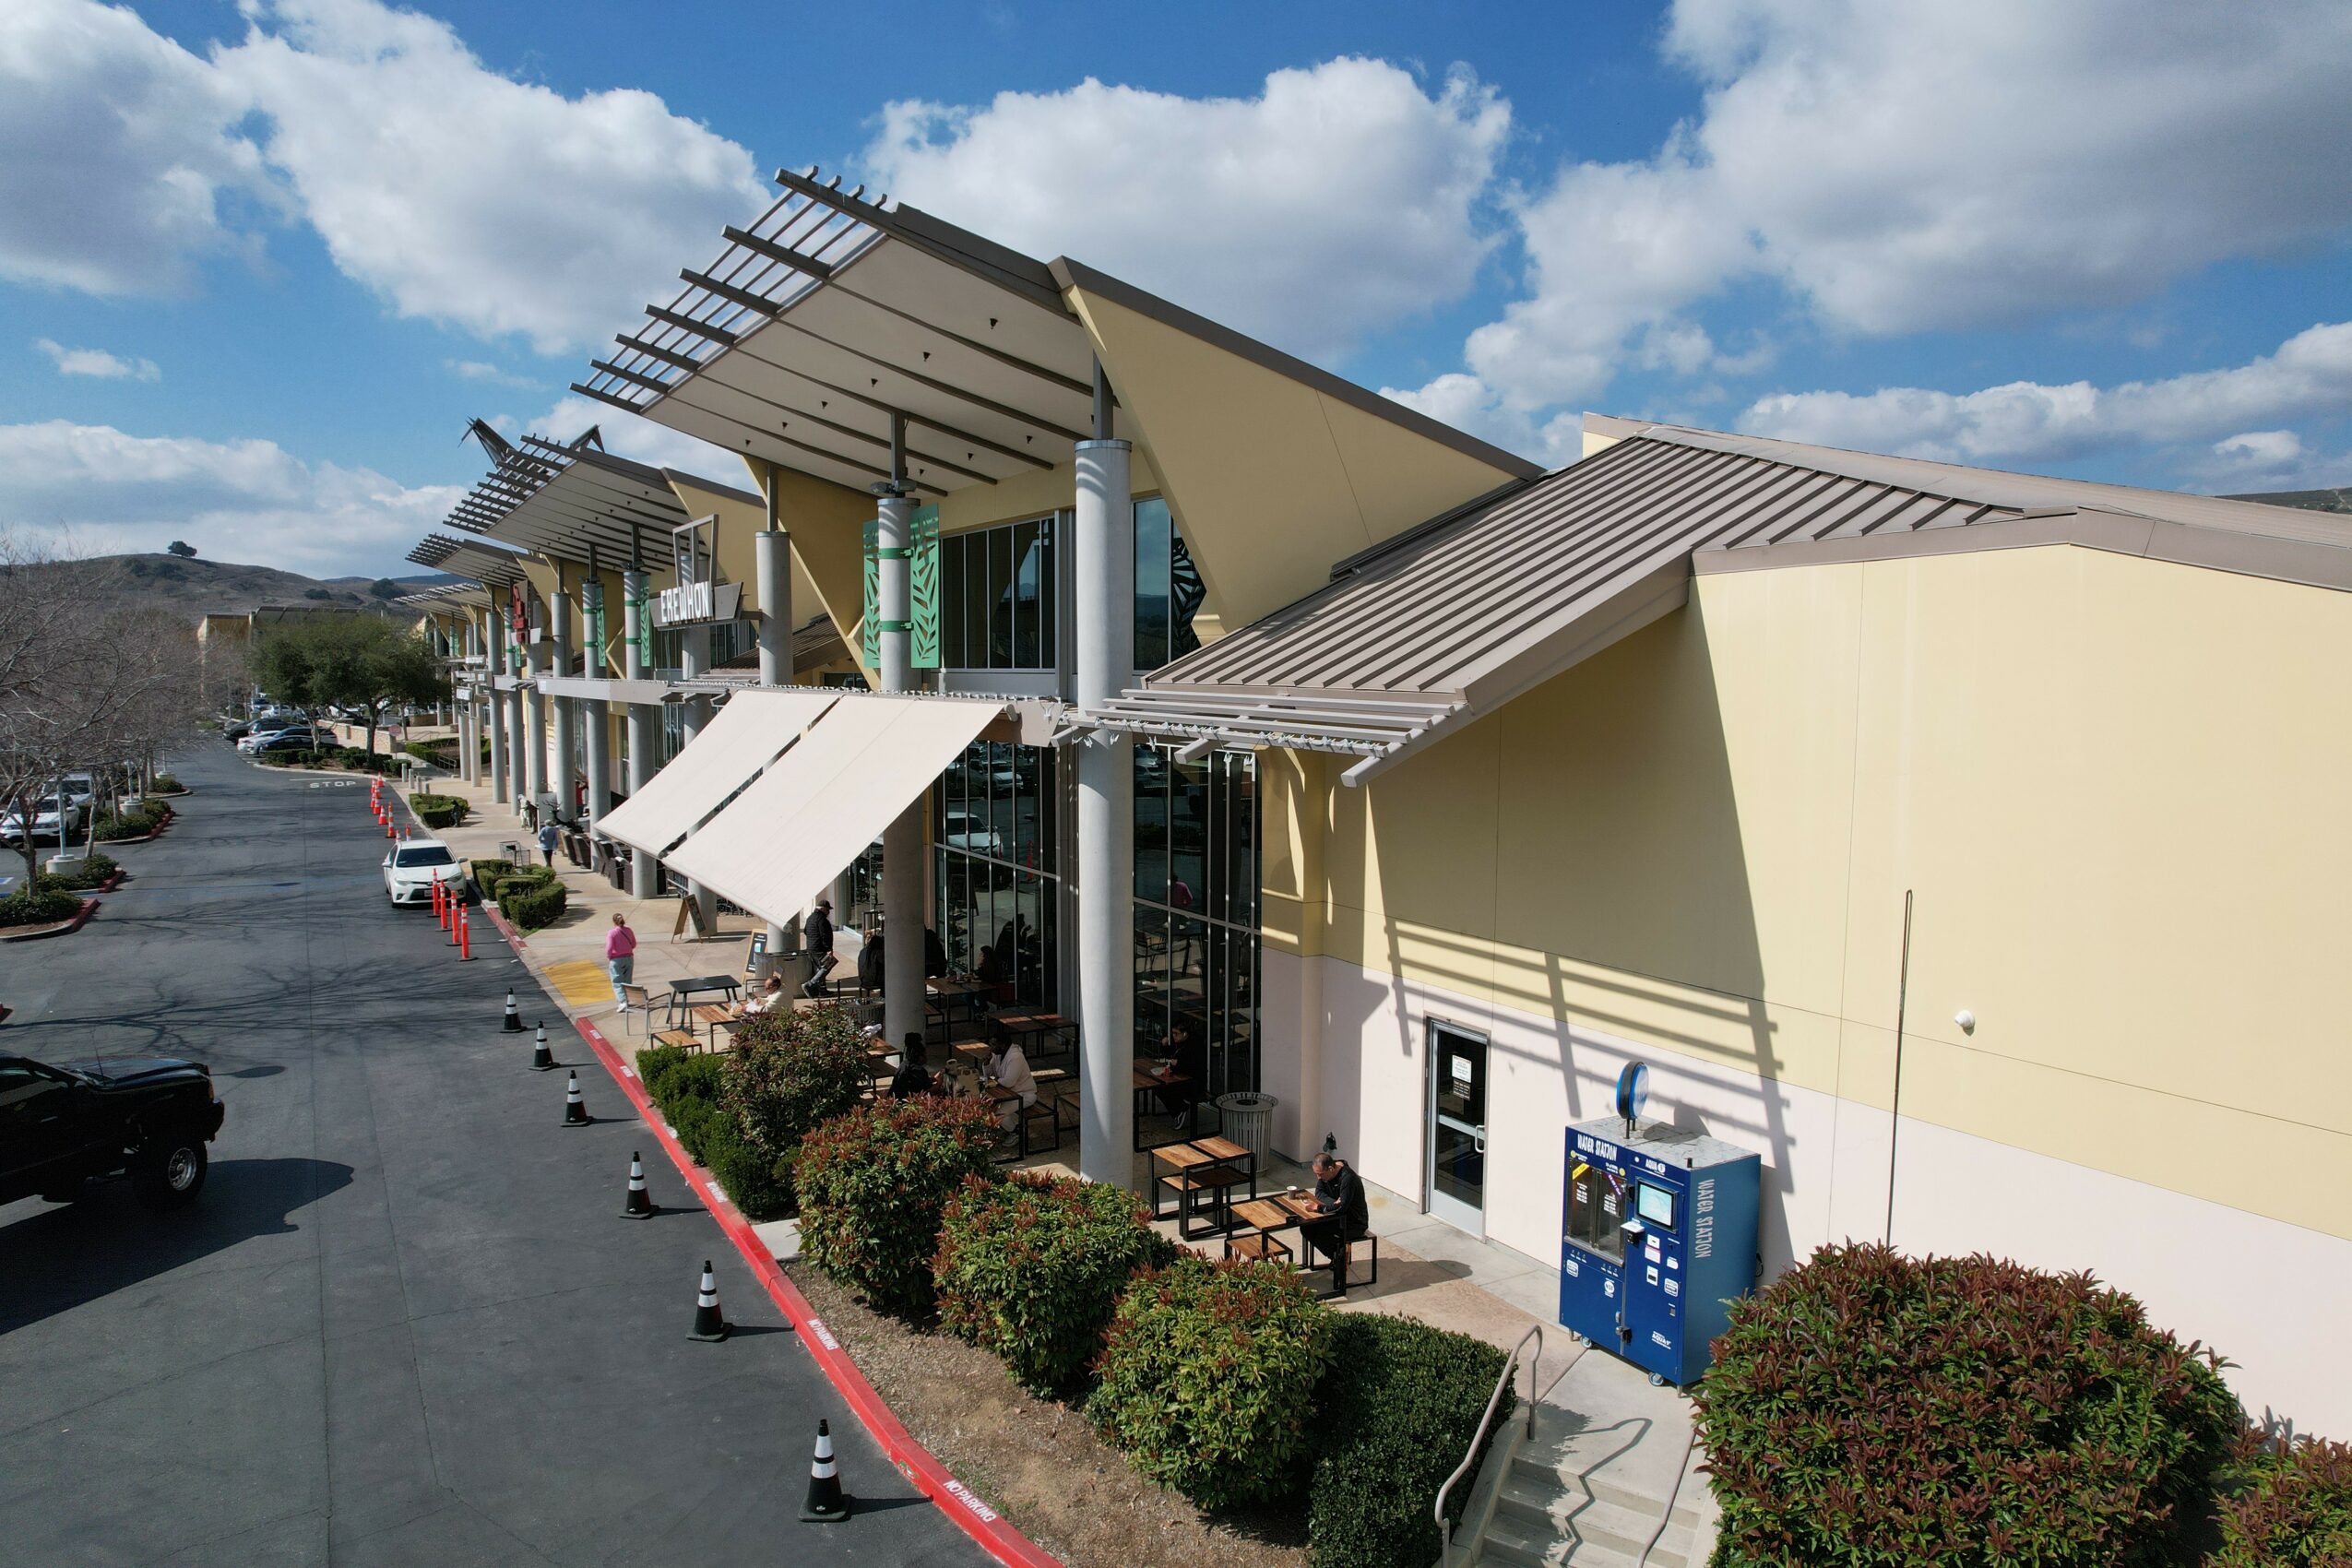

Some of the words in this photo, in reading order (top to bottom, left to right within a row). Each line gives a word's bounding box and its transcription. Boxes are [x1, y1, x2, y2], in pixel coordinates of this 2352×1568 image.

[659, 581, 712, 624] EREWHON
[309, 780, 357, 789] STOP
[1577, 1134, 1594, 1154] WATER
[1595, 1139, 1618, 1161] STATION
[1696, 1179, 1716, 1215] WATER
[1694, 1216, 1714, 1259] STATION
[806, 1318, 822, 1328] NO
[813, 1326, 839, 1350] PARKING
[943, 1479, 963, 1492] NO
[954, 1490, 997, 1523] PARKING
